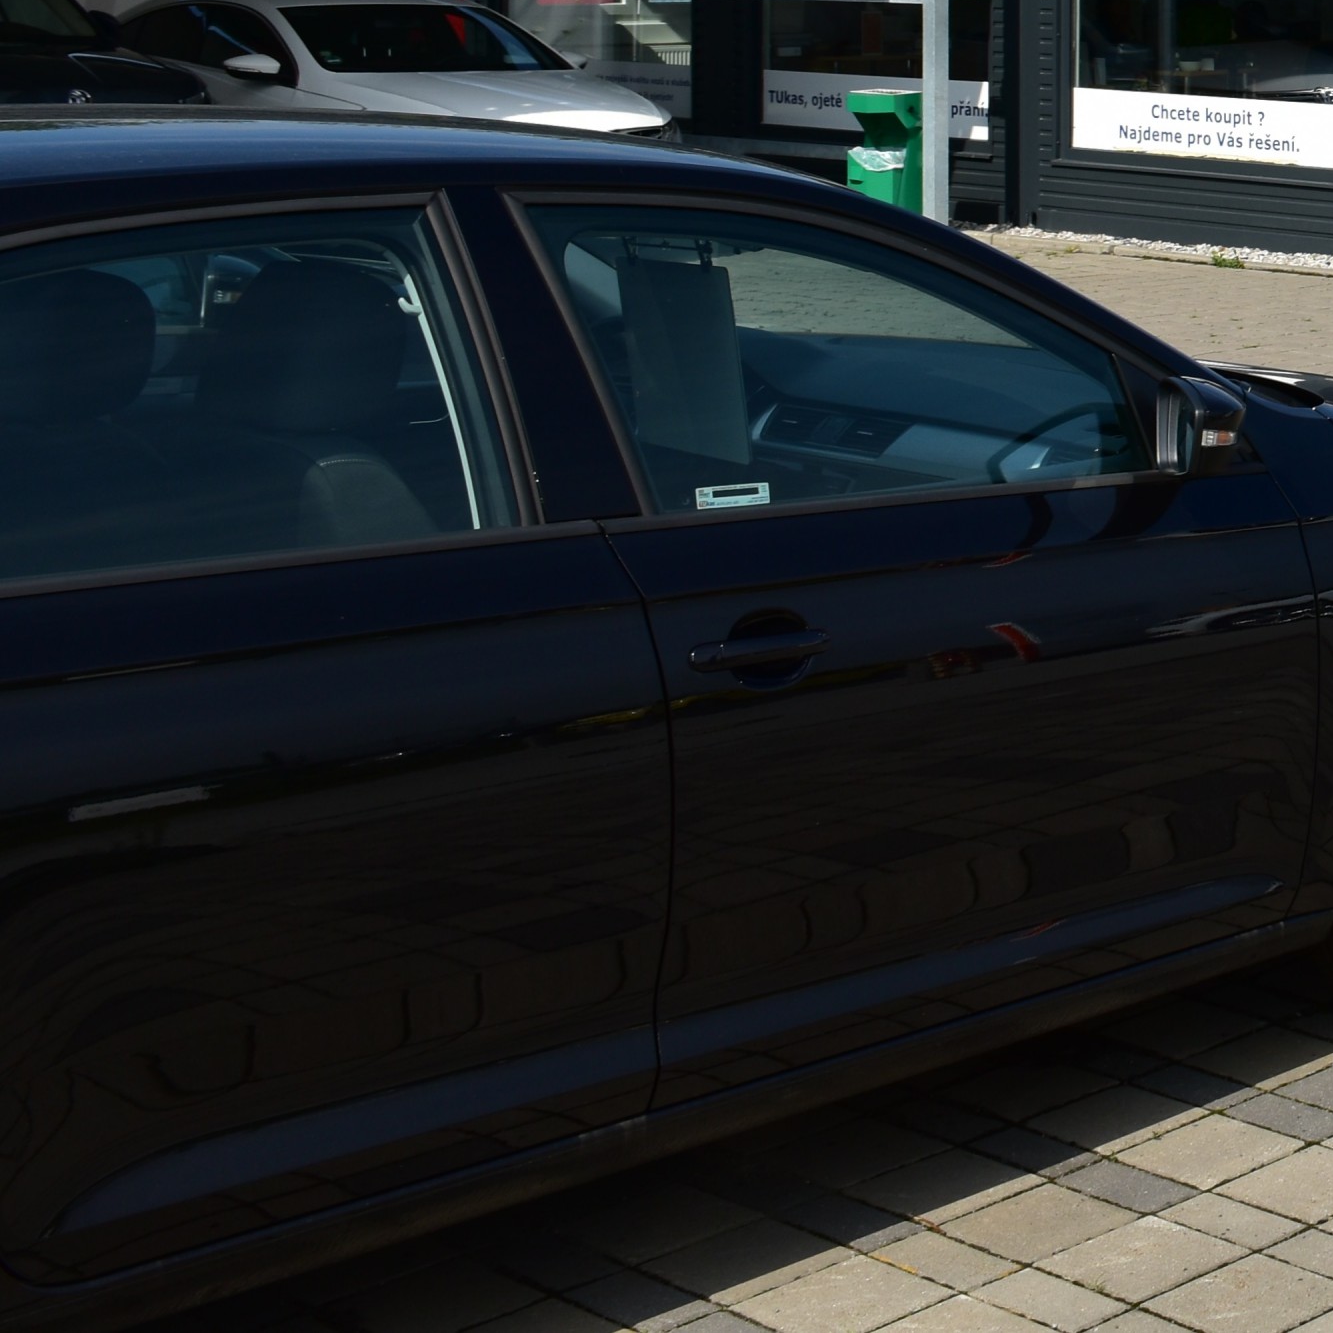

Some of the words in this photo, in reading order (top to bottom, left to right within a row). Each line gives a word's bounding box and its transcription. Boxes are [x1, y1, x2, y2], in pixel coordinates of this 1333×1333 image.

[768, 89, 808, 109] TUkas,
[811, 93, 842, 109] ojeté
[1151, 104, 1200, 122] Chcete
[1205, 107, 1253, 128] koupit
[1258, 111, 1265, 126] ?
[1119, 124, 1182, 144] Najdeme
[1188, 133, 1211, 148] pro
[1217, 131, 1243, 148] Vás
[1249, 133, 1300, 153] řešení.
